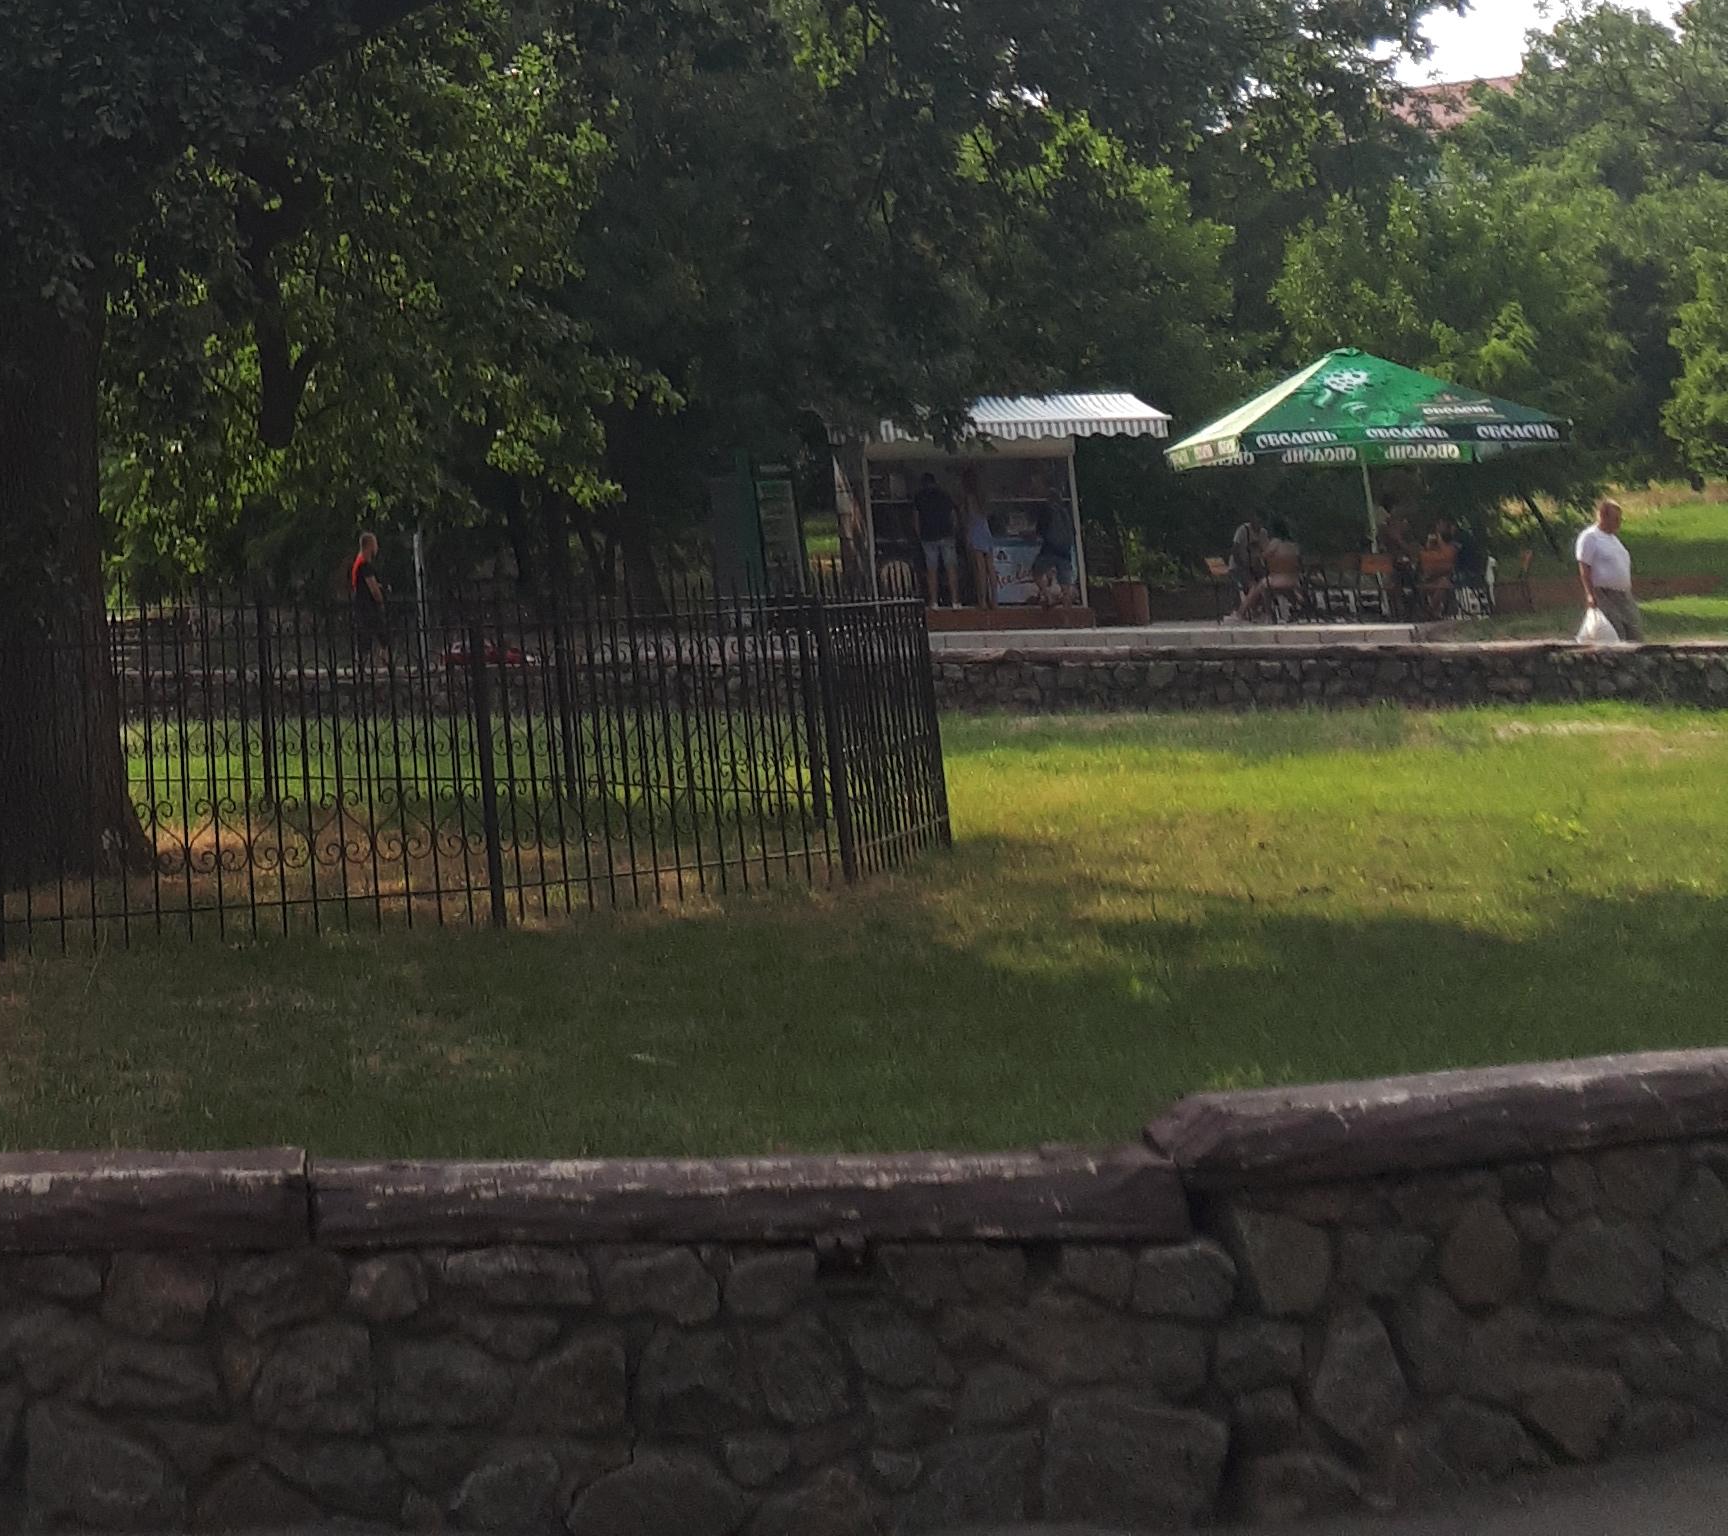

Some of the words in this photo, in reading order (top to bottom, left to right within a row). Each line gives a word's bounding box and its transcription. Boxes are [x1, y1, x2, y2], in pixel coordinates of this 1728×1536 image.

[1256, 430, 1337, 448] ОБОЛОНЬ
[1365, 425, 1449, 438] ОБОЛОНЬ
[1476, 423, 1560, 439] ОБОЛОНЬ
